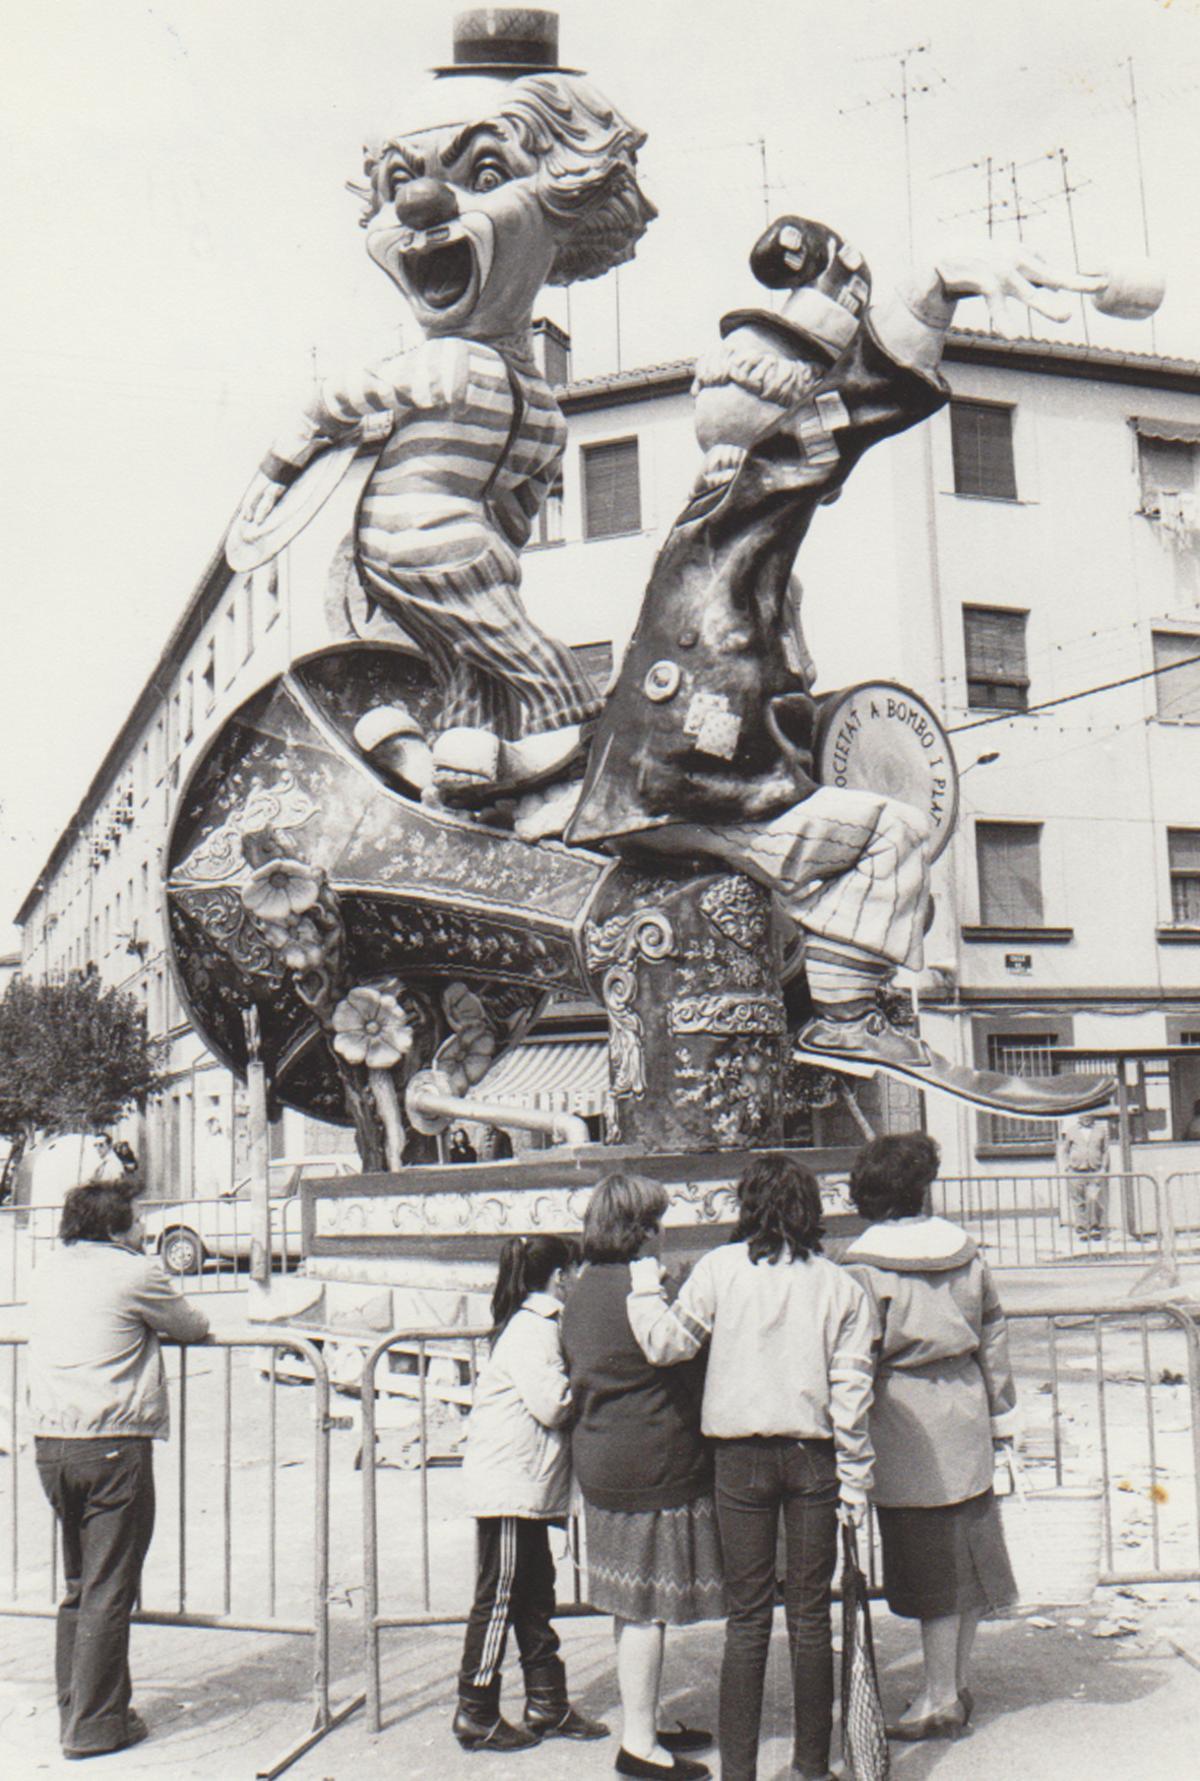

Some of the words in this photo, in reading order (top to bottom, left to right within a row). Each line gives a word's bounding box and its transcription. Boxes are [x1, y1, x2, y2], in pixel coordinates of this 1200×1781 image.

[871, 701, 880, 719] A
[886, 698, 934, 748] BOMBO
[930, 756, 943, 767] I
